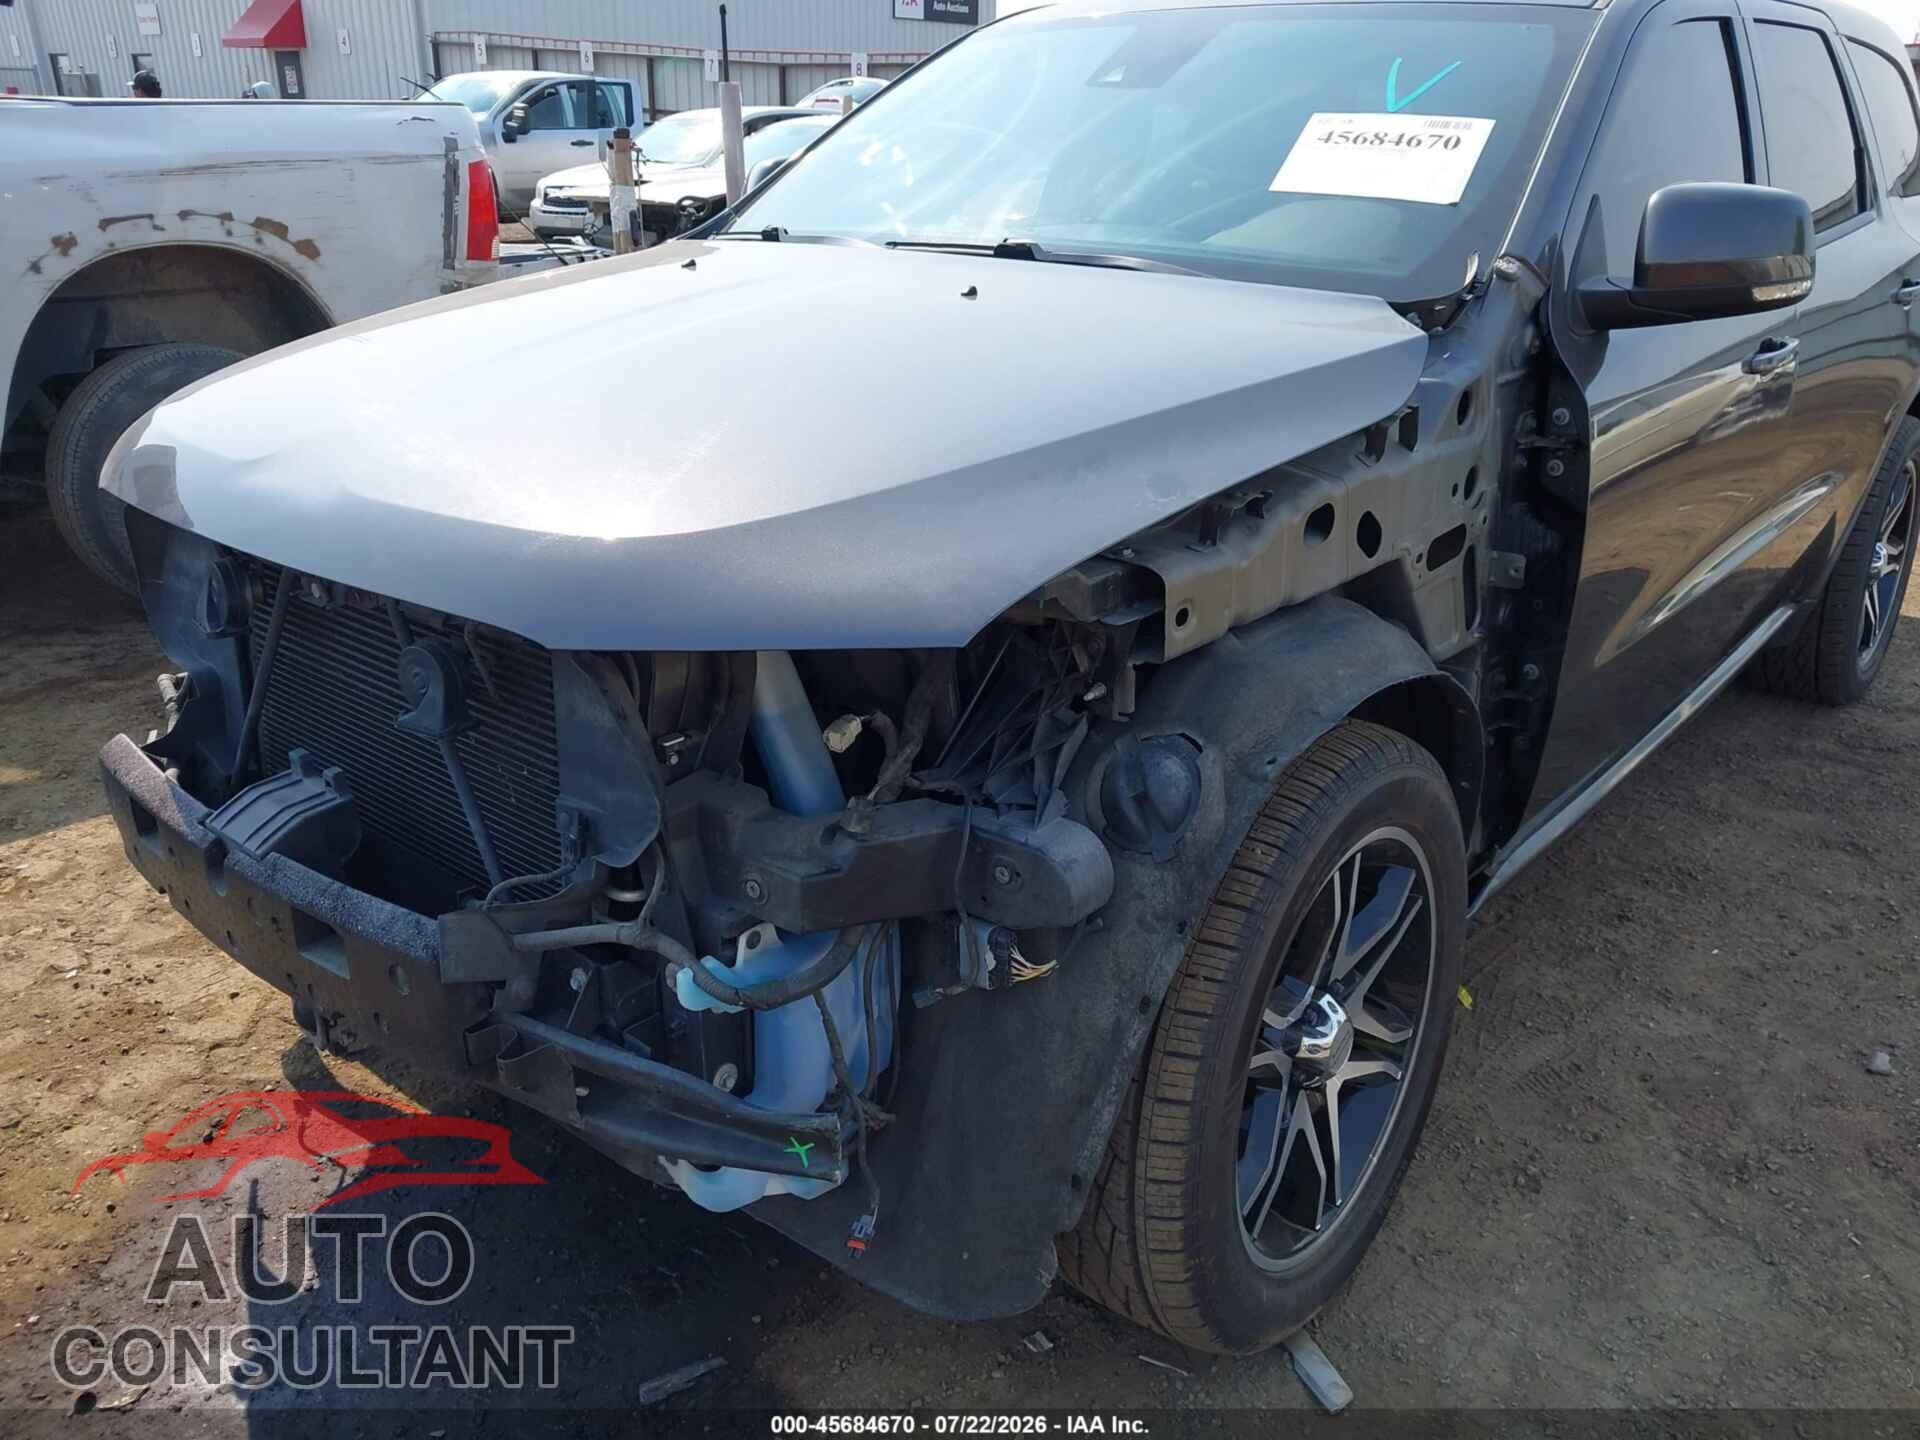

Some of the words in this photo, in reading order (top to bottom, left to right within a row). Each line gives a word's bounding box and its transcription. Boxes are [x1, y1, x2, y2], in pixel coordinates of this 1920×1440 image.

[477, 42, 484, 56] 5
[584, 51, 590, 63] 6
[708, 59, 714, 73] 7
[856, 62, 863, 77] 8
[1317, 130, 1462, 151] 45684670
